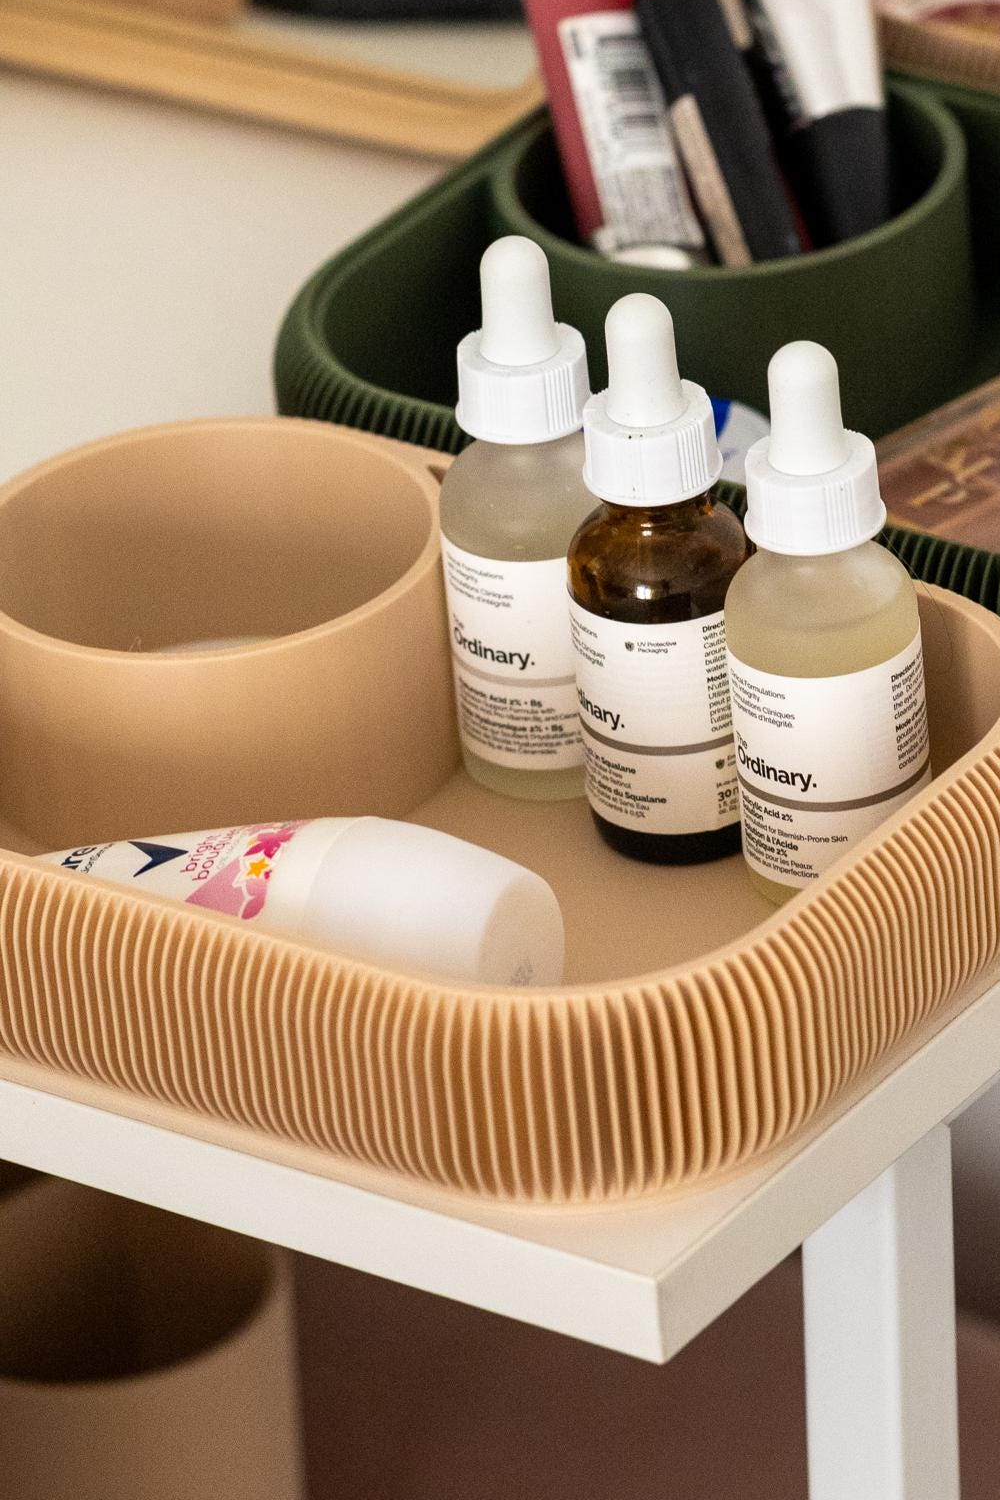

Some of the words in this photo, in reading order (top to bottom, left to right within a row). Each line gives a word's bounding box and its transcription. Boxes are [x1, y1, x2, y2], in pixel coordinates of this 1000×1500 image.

[454, 625, 536, 671] Ordinary.
[647, 641, 677, 649] Protective
[707, 672, 727, 684] Mode
[577, 687, 626, 732] dinary.
[762, 706, 796, 722] Cliniques
[895, 718, 911, 733] Mode
[601, 756, 637, 775] Squalane
[738, 744, 818, 792] Ordinary.
[625, 791, 667, 805] Squalane
[763, 805, 781, 820] Acid
[781, 812, 794, 824] 2%
[777, 828, 830, 844] Blemish-Prone
[830, 834, 849, 844] Skin
[772, 836, 799, 853] l'Acide
[776, 847, 788, 859] 2%
[772, 861, 820, 880] Imperfections
[790, 860, 814, 871] Peaux
